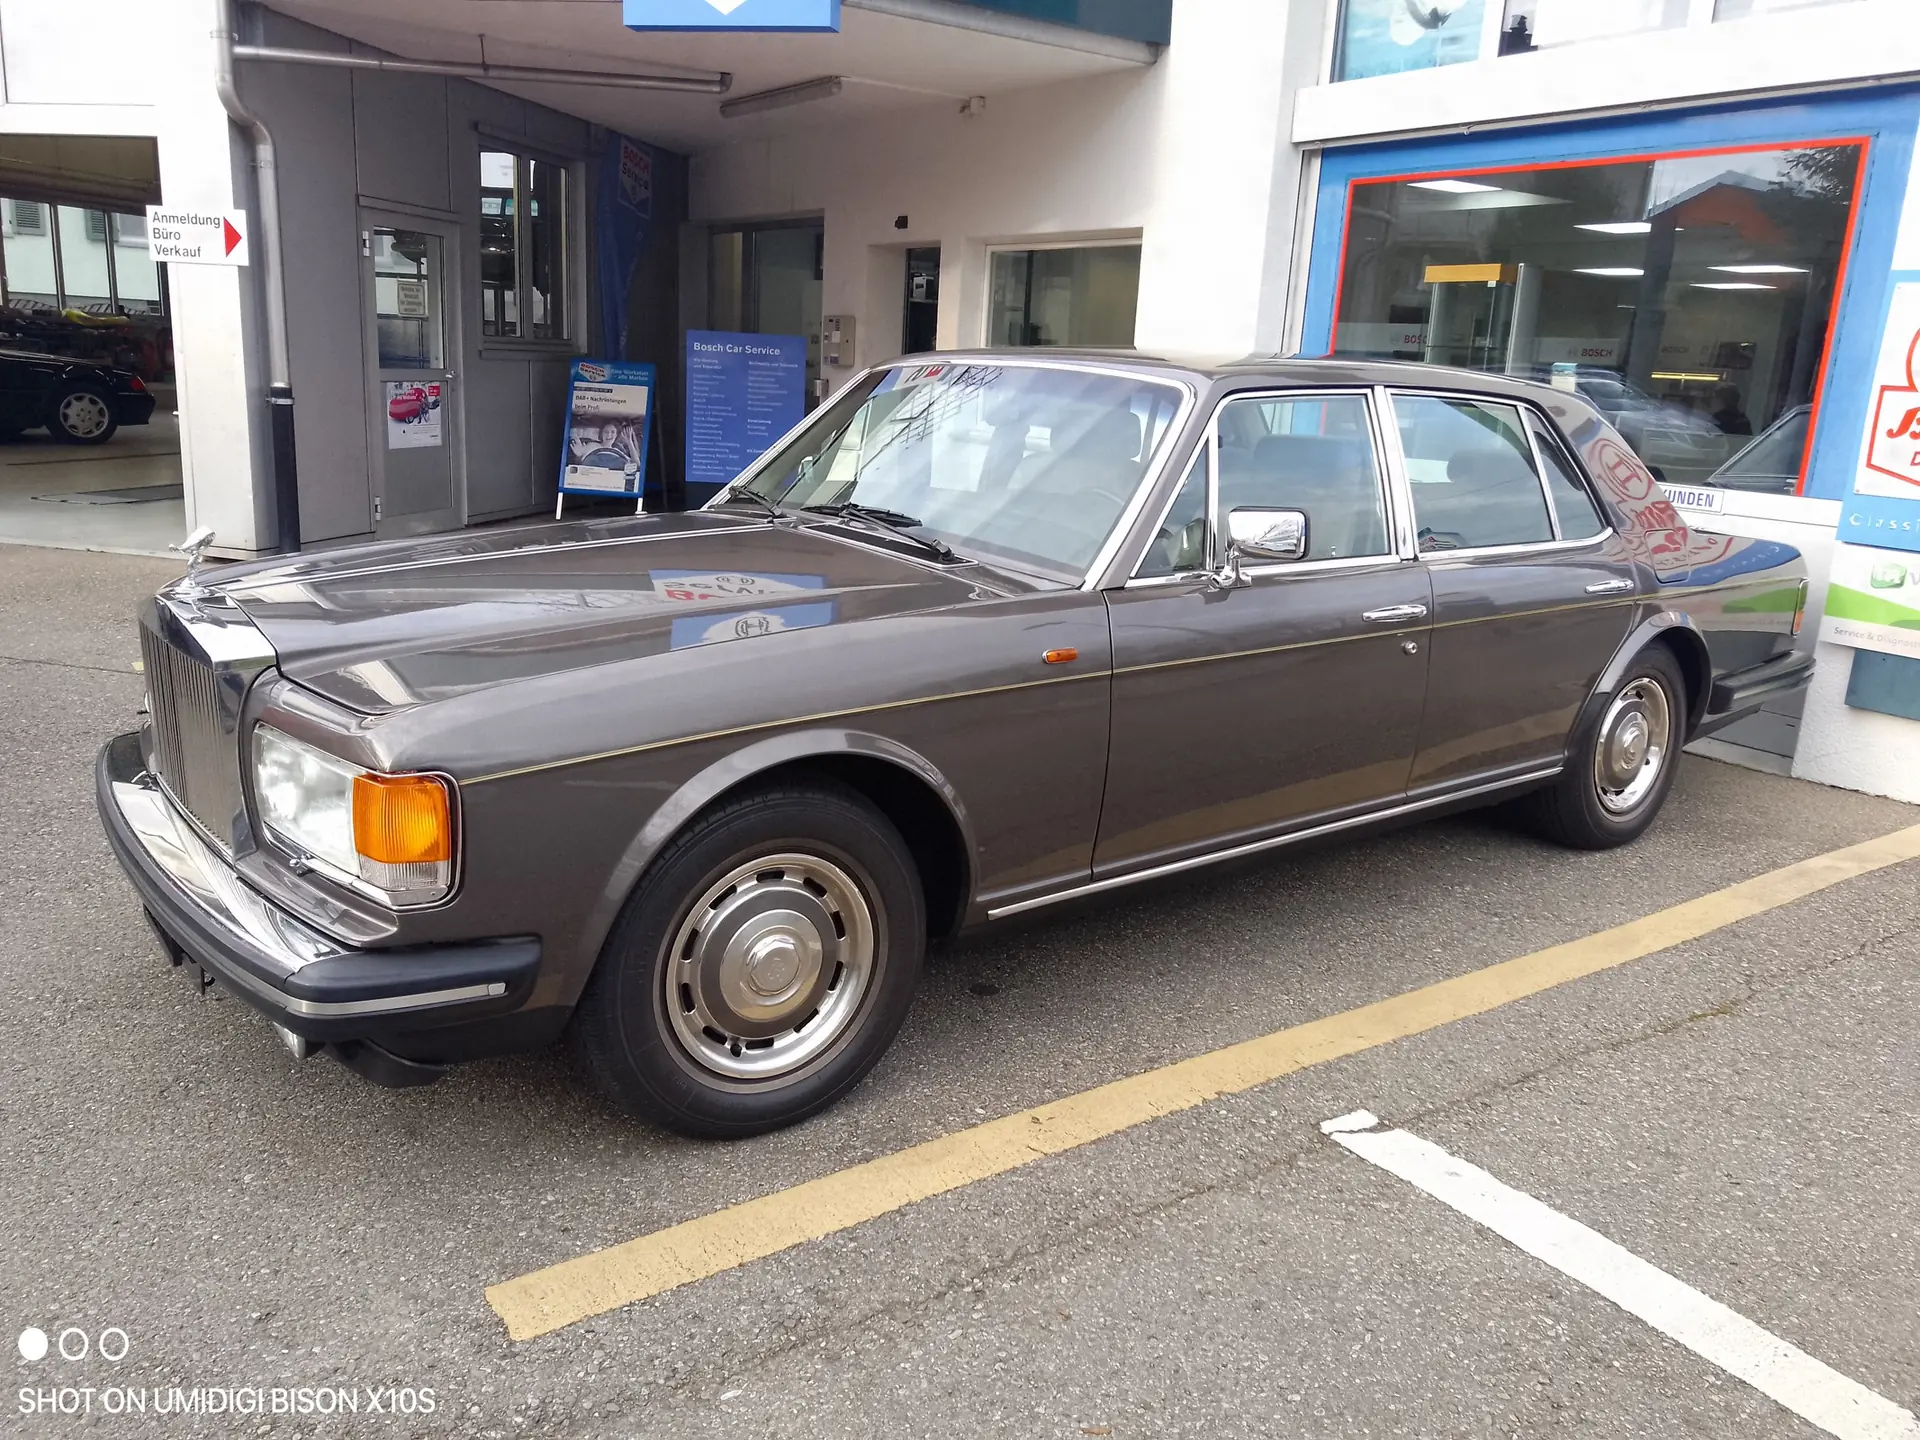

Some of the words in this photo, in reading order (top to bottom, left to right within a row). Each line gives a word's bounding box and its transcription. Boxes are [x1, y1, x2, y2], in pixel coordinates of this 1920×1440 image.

[152, 211, 221, 229] Anmeldung
[152, 227, 181, 241] Büro
[154, 243, 202, 258] Verkauf
[693, 342, 723, 353] Bosch
[726, 344, 743, 353] Car
[745, 345, 781, 356] Service
[1581, 347, 1614, 357] BOSCH
[1833, 626, 1865, 640] Service
